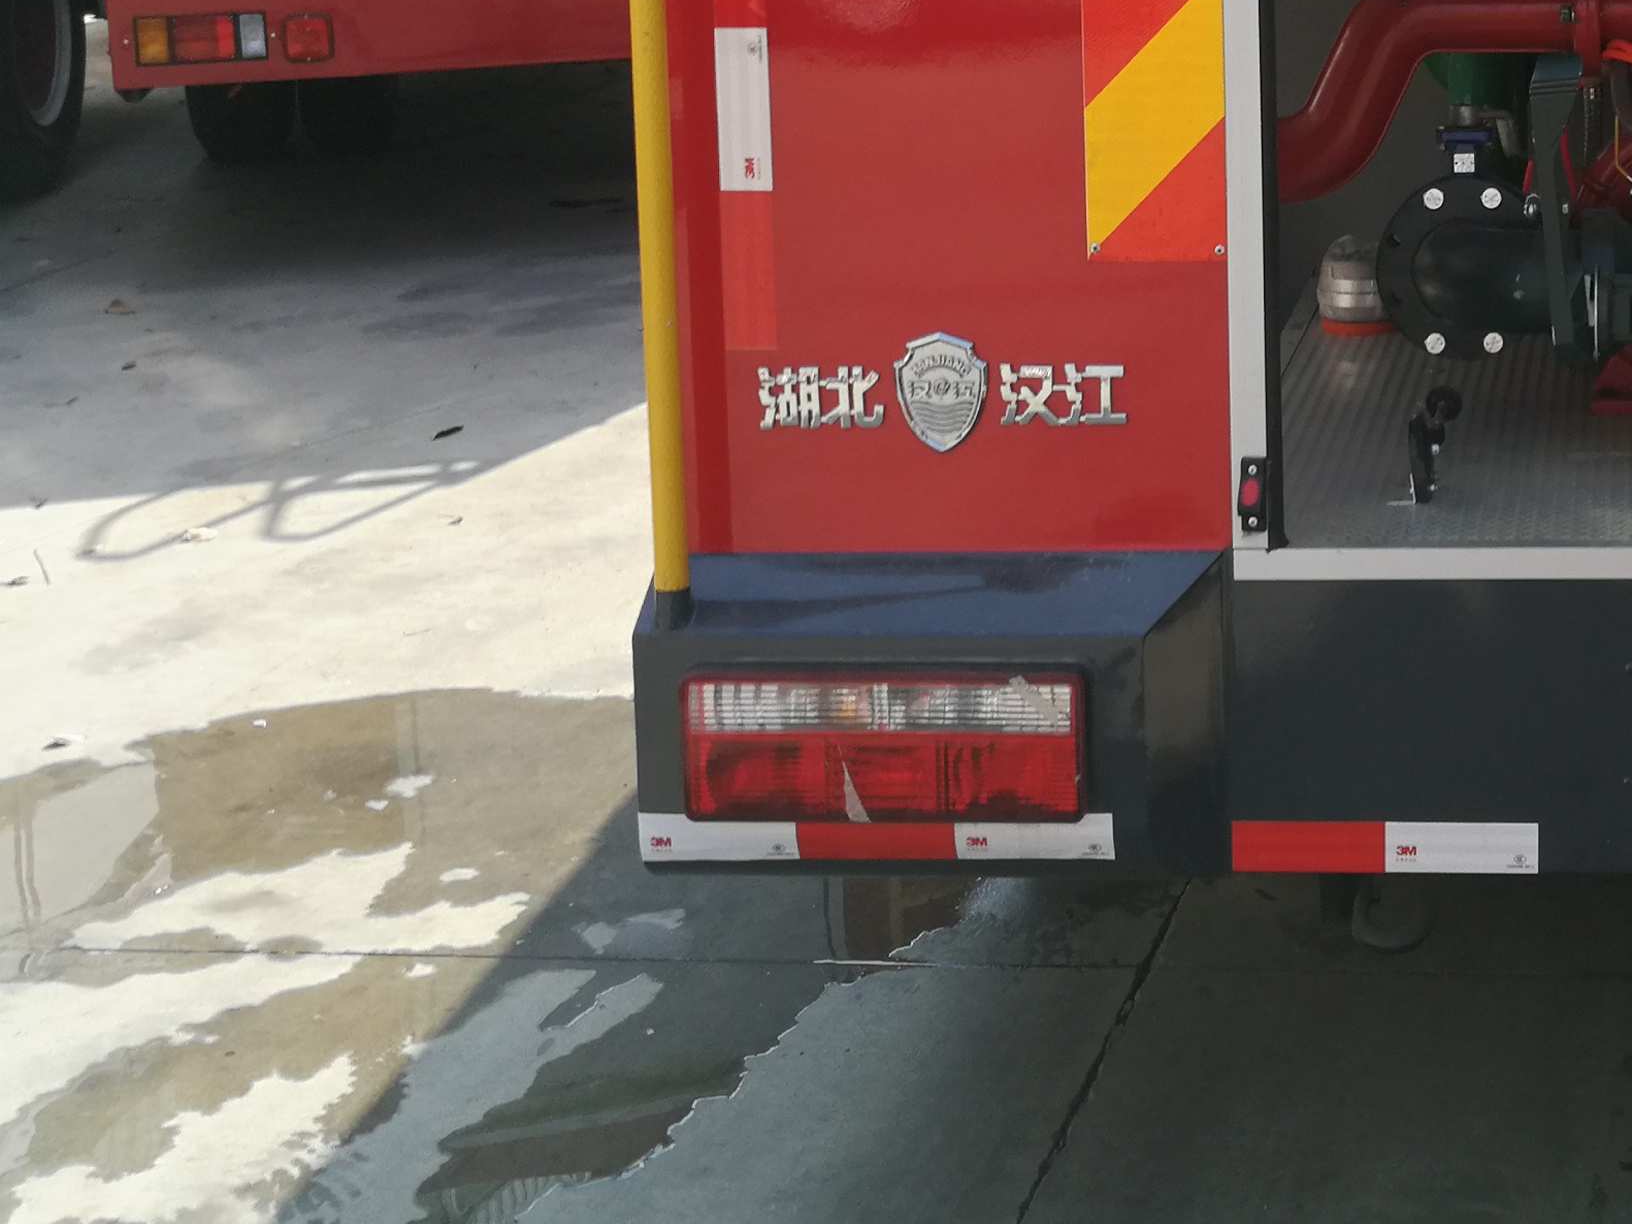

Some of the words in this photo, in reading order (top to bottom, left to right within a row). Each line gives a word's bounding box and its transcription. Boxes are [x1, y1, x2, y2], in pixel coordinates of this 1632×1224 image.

[745, 158, 755, 179] 3M
[757, 365, 885, 429] 湖北
[999, 362, 1129, 427] 汉江
[650, 836, 673, 849] 3M
[966, 836, 989, 849] 3M
[1396, 845, 1417, 856] 3M
